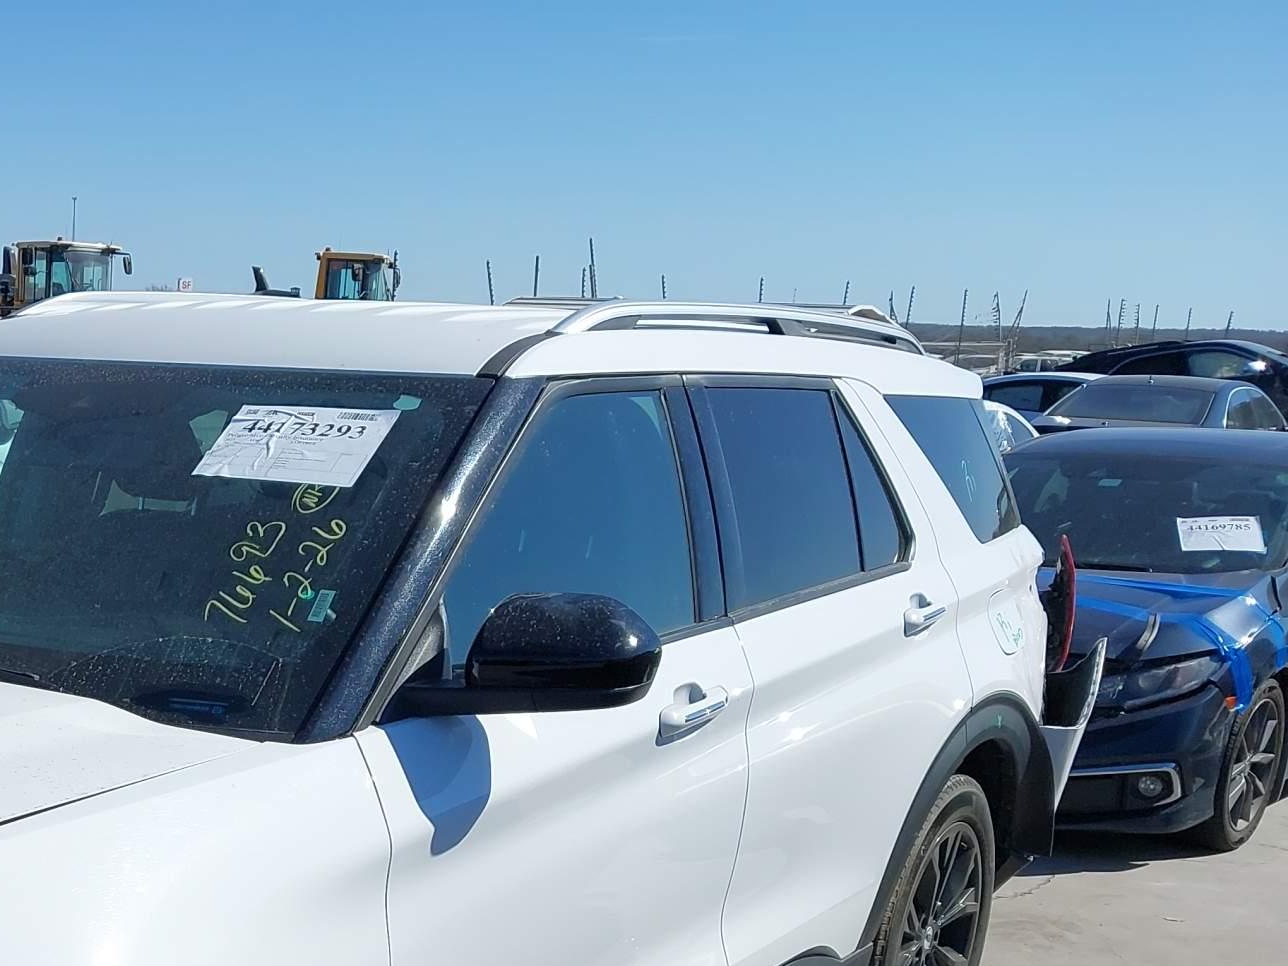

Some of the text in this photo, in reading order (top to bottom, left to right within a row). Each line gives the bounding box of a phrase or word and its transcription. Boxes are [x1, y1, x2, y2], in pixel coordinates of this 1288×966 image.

[242, 419, 368, 439] 44173293
[1186, 523, 1251, 531] 44169785
[204, 521, 286, 623] 76693
[269, 519, 347, 633] 1-2-26
